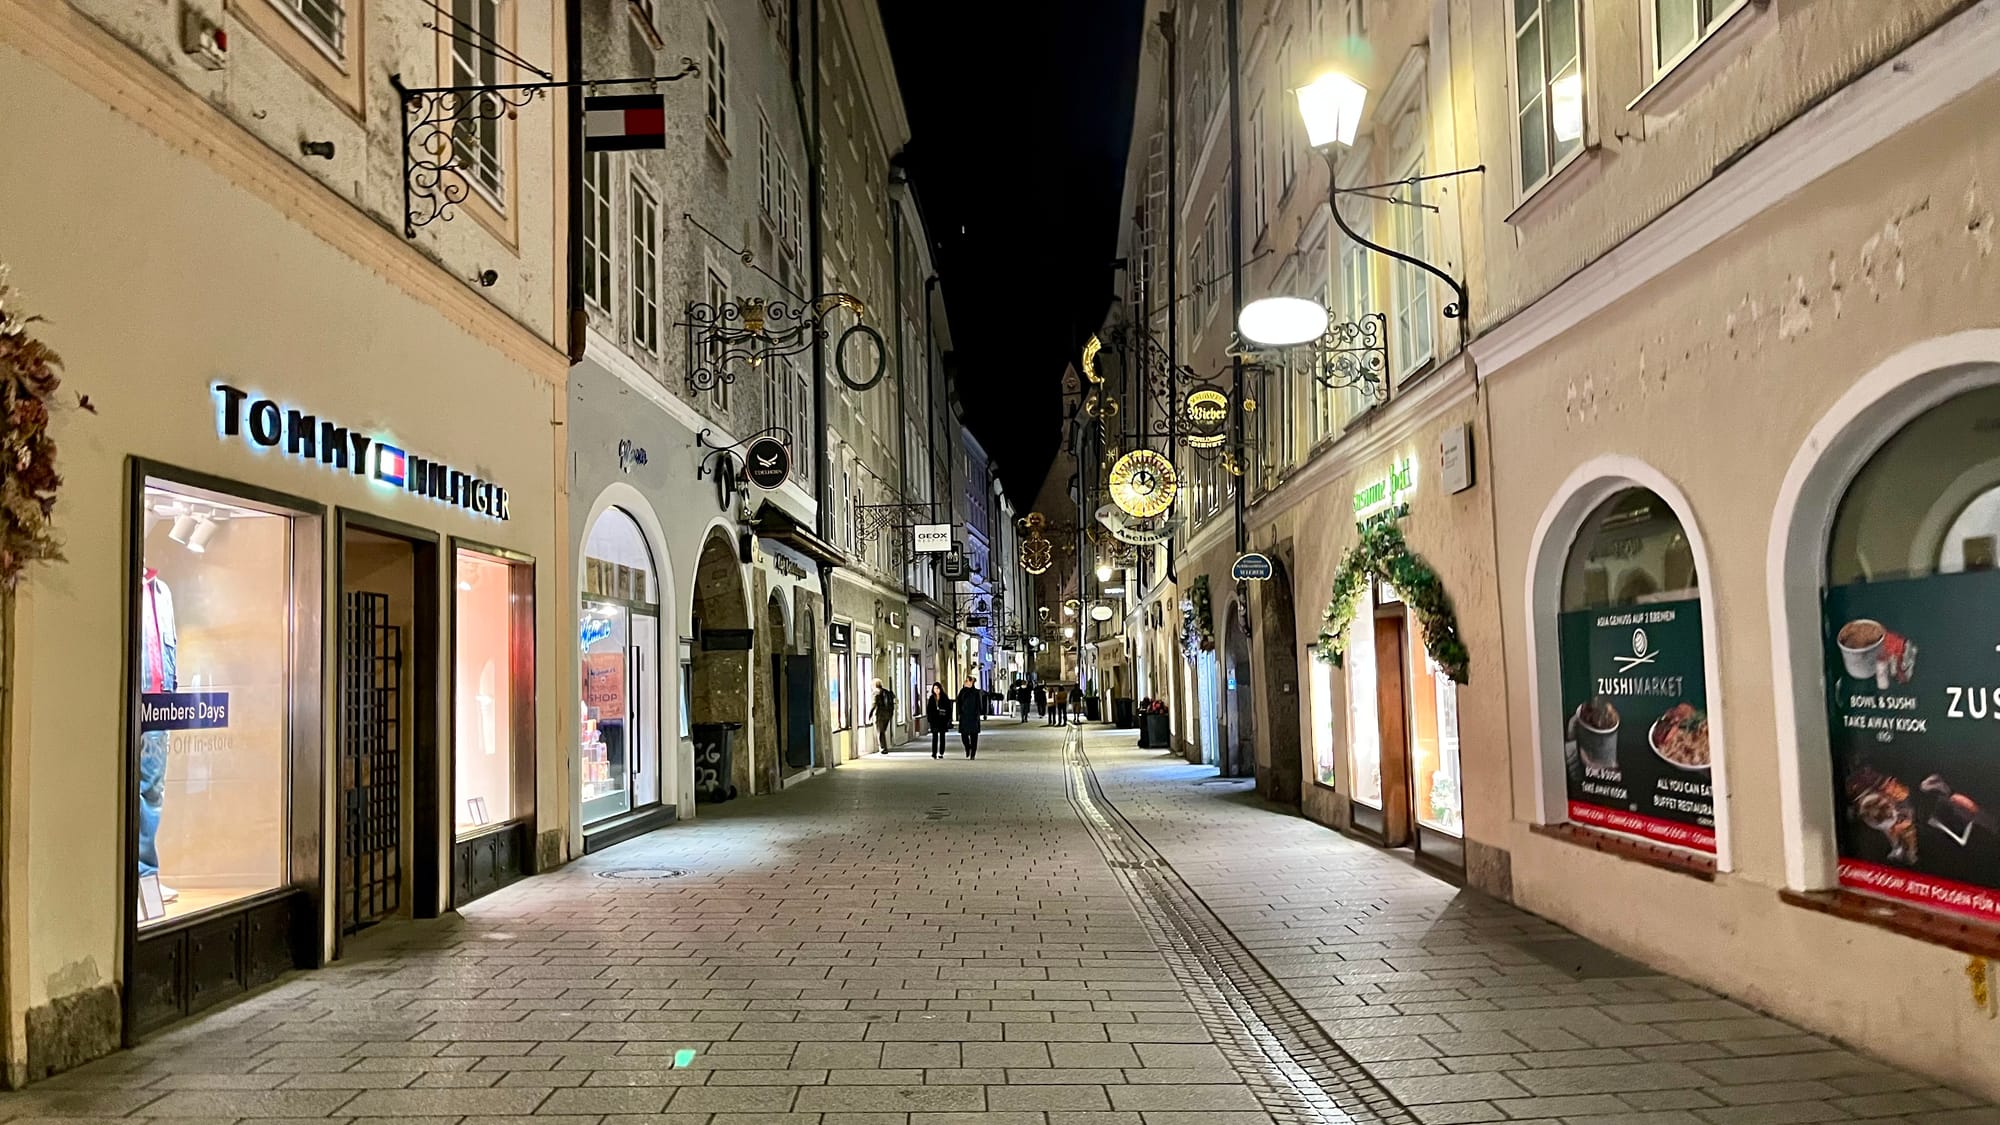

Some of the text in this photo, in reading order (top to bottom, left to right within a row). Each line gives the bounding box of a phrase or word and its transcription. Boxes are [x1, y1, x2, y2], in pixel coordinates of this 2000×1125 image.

[1187, 406, 1227, 420] Wieber
[216, 385, 510, 521] TOMMY HILFIGER
[1116, 527, 1174, 542] Aschauer
[1598, 676, 1683, 697] ZUSHIMARKET
[1850, 695, 1876, 709] BOWL
[1886, 696, 1917, 710] SUSHI
[141, 701, 225, 723] Members Days
[1843, 715, 1866, 729] TAKE
[1867, 717, 1895, 731] AWAY
[1657, 778, 1668, 790] ALL
[1670, 779, 1683, 792] YOU
[1684, 781, 1699, 795] CAN
[1653, 794, 1677, 809] BUFFET
